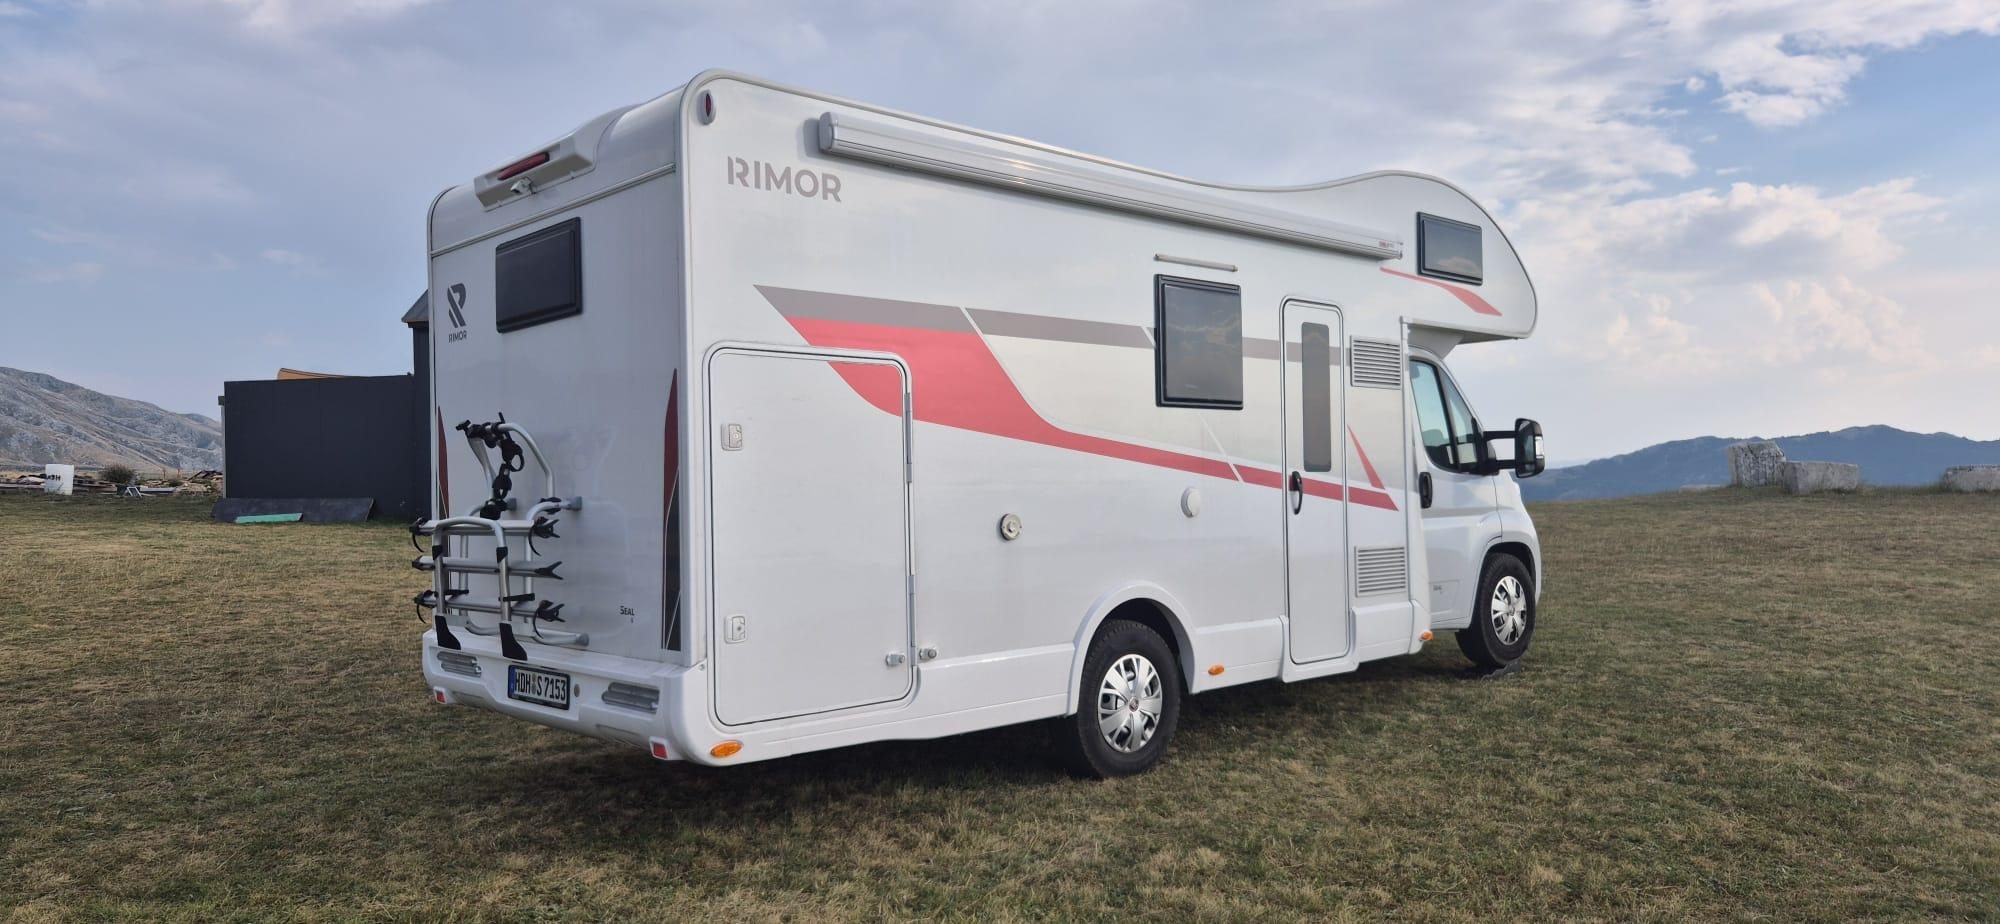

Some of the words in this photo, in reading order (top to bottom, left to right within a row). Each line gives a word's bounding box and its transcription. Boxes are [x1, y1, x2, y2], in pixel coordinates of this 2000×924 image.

[727, 155, 842, 203] RIMOR
[448, 330, 468, 343] RIMOR
[515, 671, 531, 695] HDH
